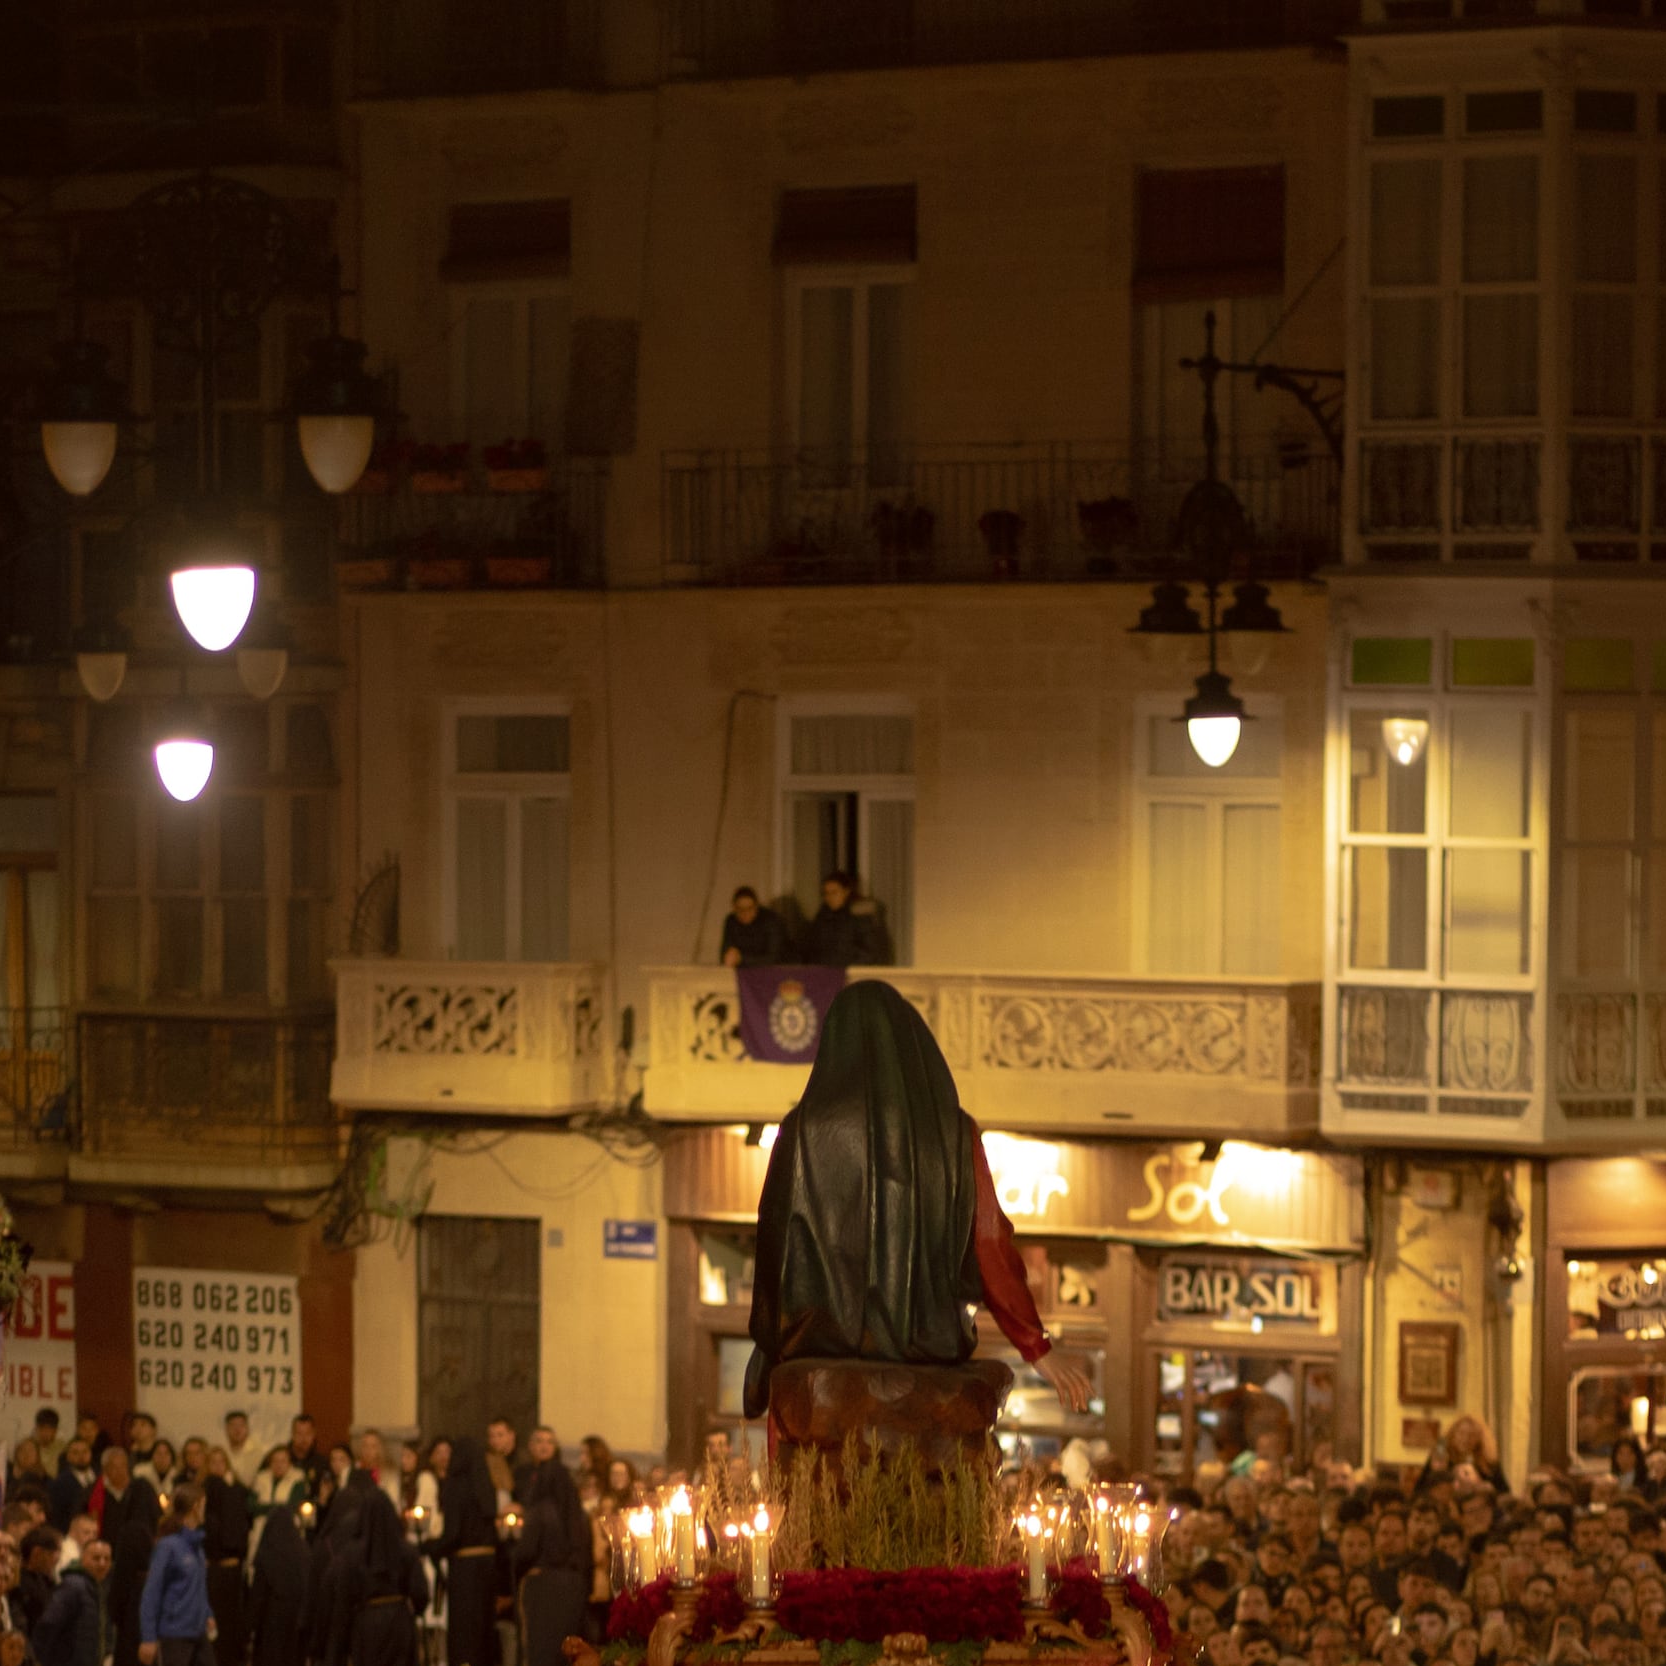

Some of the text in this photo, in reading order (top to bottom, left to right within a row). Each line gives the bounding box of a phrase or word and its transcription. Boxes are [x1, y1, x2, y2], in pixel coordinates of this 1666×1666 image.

[1127, 1152, 1231, 1226] Sol
[137, 1279, 292, 1315] 868 062 206
[1165, 1267, 1319, 1318] BAR SOL
[138, 1319, 289, 1355] 620 240 971
[139, 1359, 293, 1394] 620 240 973
